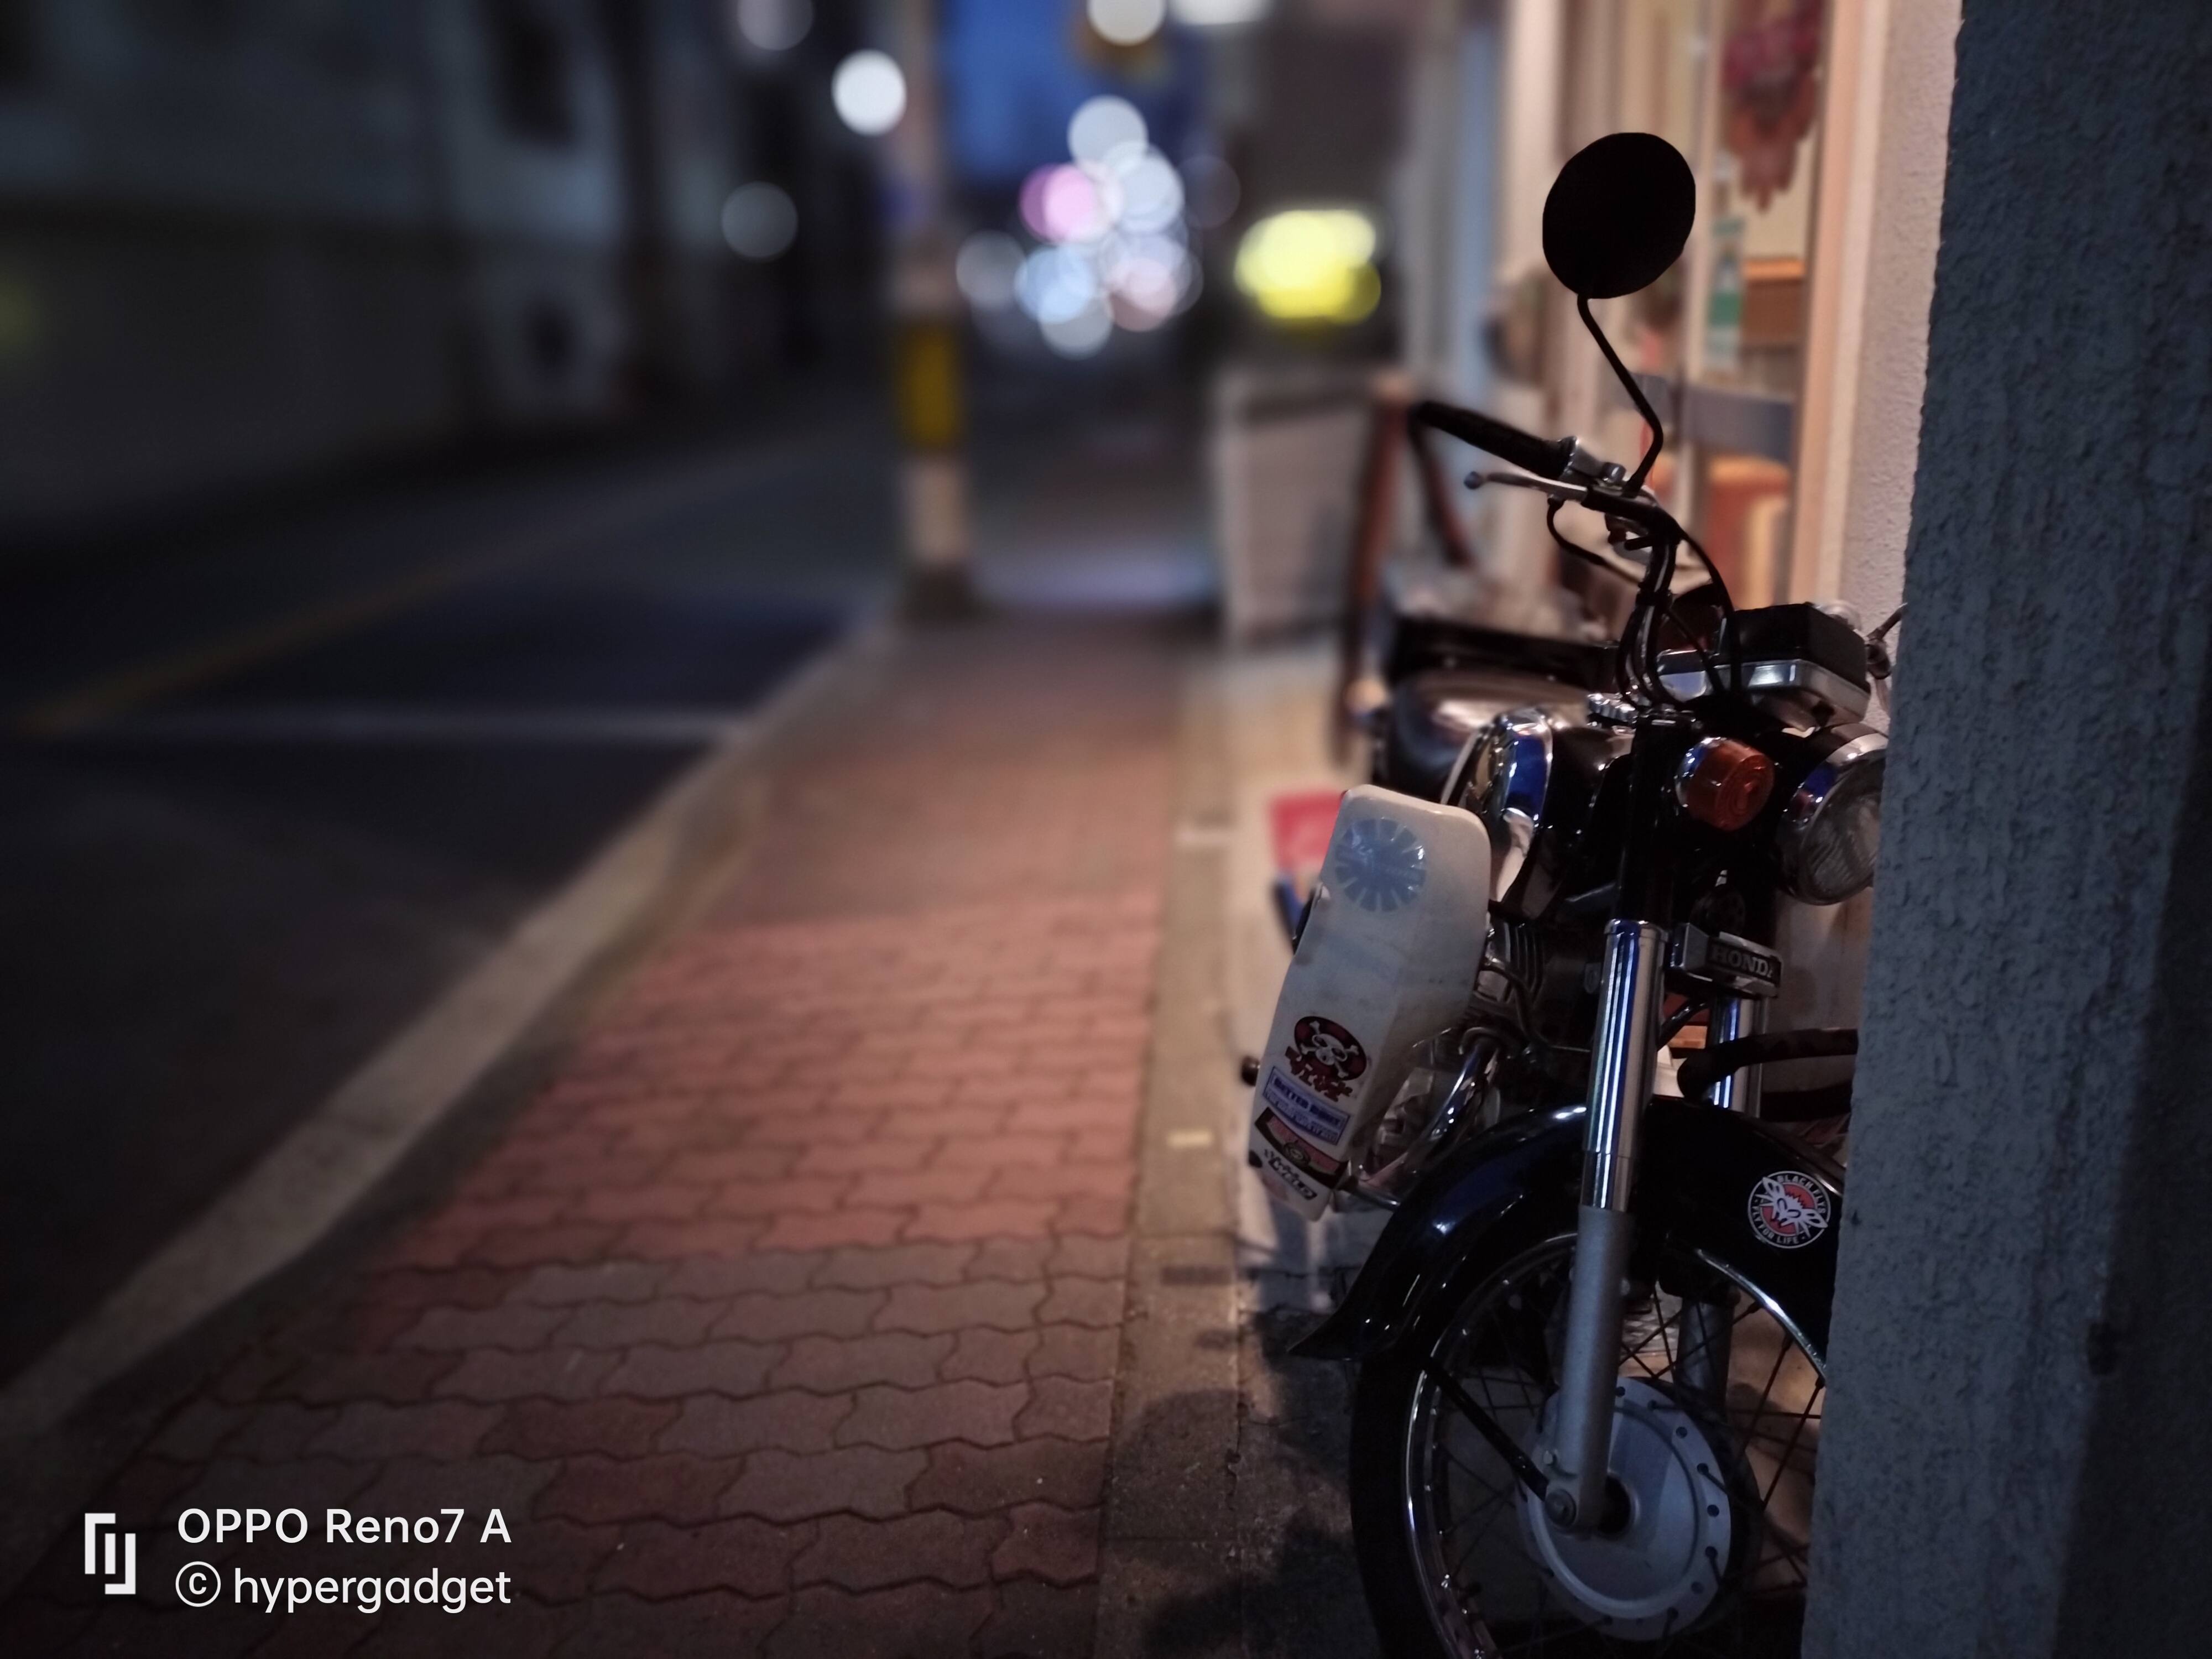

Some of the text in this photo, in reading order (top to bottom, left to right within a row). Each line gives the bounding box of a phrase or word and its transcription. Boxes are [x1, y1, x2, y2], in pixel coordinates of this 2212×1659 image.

[1776, 1174, 1827, 1213] BLACK FLYS
[1776, 1236, 1800, 1244] LIFE
